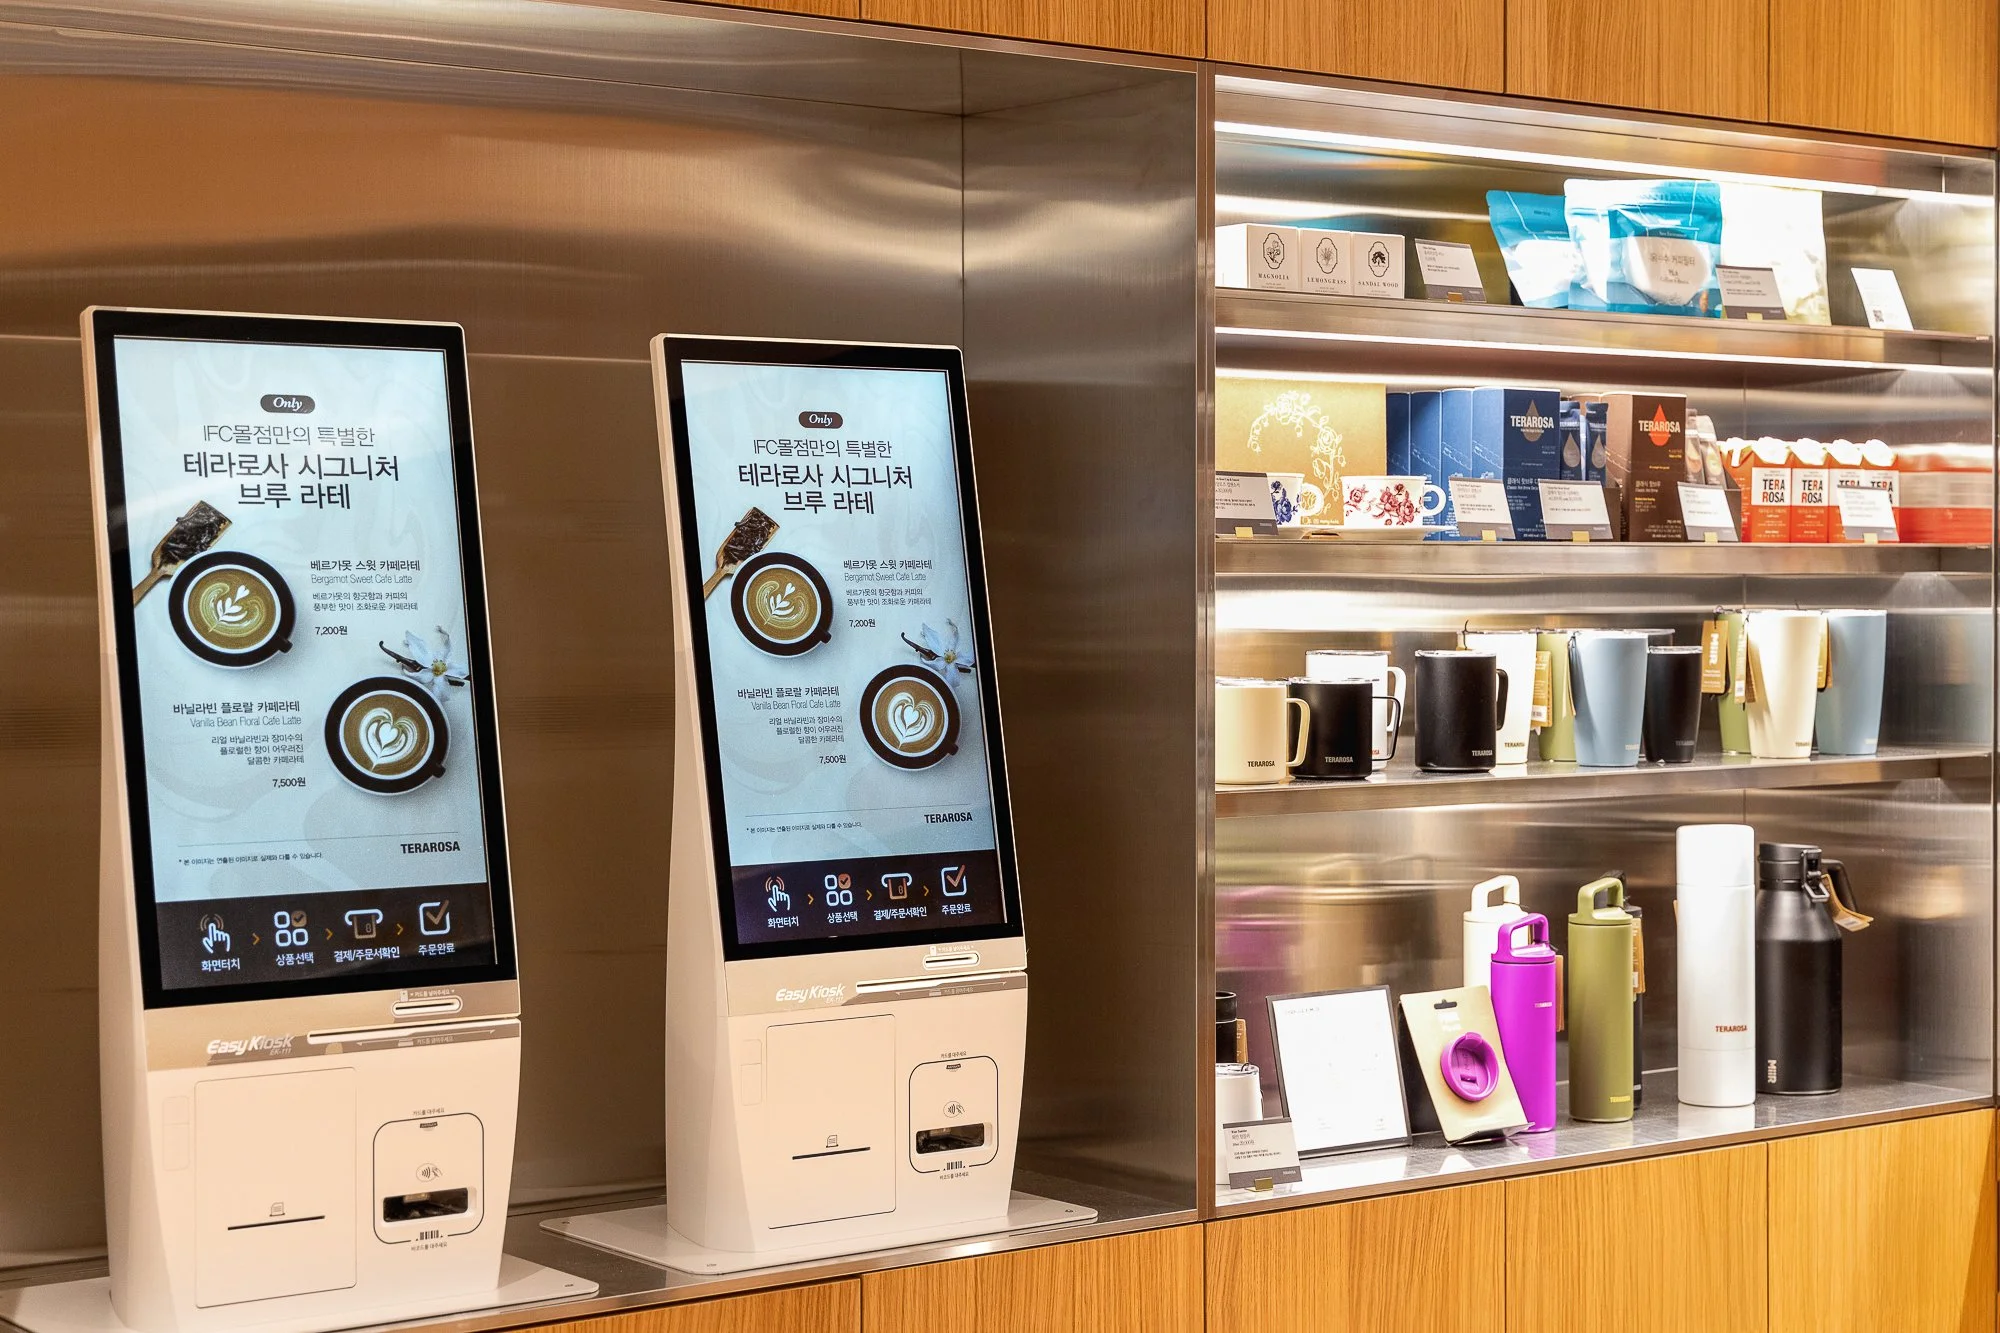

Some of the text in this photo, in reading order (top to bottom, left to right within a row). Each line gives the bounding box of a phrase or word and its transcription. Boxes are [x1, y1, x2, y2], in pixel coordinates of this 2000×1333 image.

[273, 397, 302, 412] Only
[809, 413, 833, 427] Only
[1510, 415, 1554, 429] TERAROSA
[1638, 420, 1681, 433] TERAROSA
[204, 425, 375, 447] IFC몰점만의 특별한
[754, 439, 892, 458] IFC몰점만의 특별한
[183, 452, 400, 481] 테라로사 시그니처
[738, 463, 912, 489] 테라로사 시그니처
[1763, 479, 1786, 490] TERA
[1802, 480, 1823, 491] TERA
[238, 484, 351, 510] 브루 라테
[784, 491, 875, 514] 브루 라테
[1762, 492, 1785, 503] ROSA
[1802, 492, 1823, 504] ROSA
[310, 560, 420, 572] 베르가못 스윗 카페라테
[844, 560, 932, 570] 베르가못 스윗 카페라테
[311, 575, 413, 586] Bergamot Sweet Cafe Latte
[844, 573, 926, 584] Bergamot Sweet Cafe Latte
[312, 592, 408, 601] 베르가못의 향긋함과 커피의
[846, 589, 877, 597] 베르가못의
[905, 588, 923, 596] 커피의
[313, 602, 418, 612] 풍부한 맛이 조화로운 카페라테
[850, 619, 876, 628] 7,200원
[315, 626, 348, 637] 7,200원
[738, 686, 840, 699] 바닐라빈 플로랄 카페라테
[173, 701, 300, 716] 바닐라빈 플로랄 카페라테
[751, 702, 772, 710] Vanilla
[773, 701, 790, 710] Bean
[810, 700, 824, 708] Cafe
[826, 700, 841, 708] Latte
[190, 716, 302, 728] Vanilla Bean Floral Cafe Latte
[769, 718, 782, 726] 리얼
[817, 716, 843, 724] 장미수의
[212, 733, 303, 745] 리얼 바닐라빈과 장미수의
[798, 736, 844, 744] 달콤한 카페라테
[254, 745, 270, 755] 향이
[272, 744, 304, 754] 어우러진
[247, 755, 304, 766] 달콤한 카페라테
[819, 755, 847, 764] 7,500원
[1248, 760, 1276, 768] TERAROSA
[272, 777, 306, 788] 7,500원
[924, 812, 973, 824] TERAROSA
[400, 841, 460, 854] TERAROSA
[767, 904, 972, 929] 화면터치 상품선택 결제/주문서확인 주문완료
[201, 944, 455, 972] 화면터치 상품선택 결제/주문서확인 주문완료
[1716, 1025, 1748, 1033] TERAROSA
